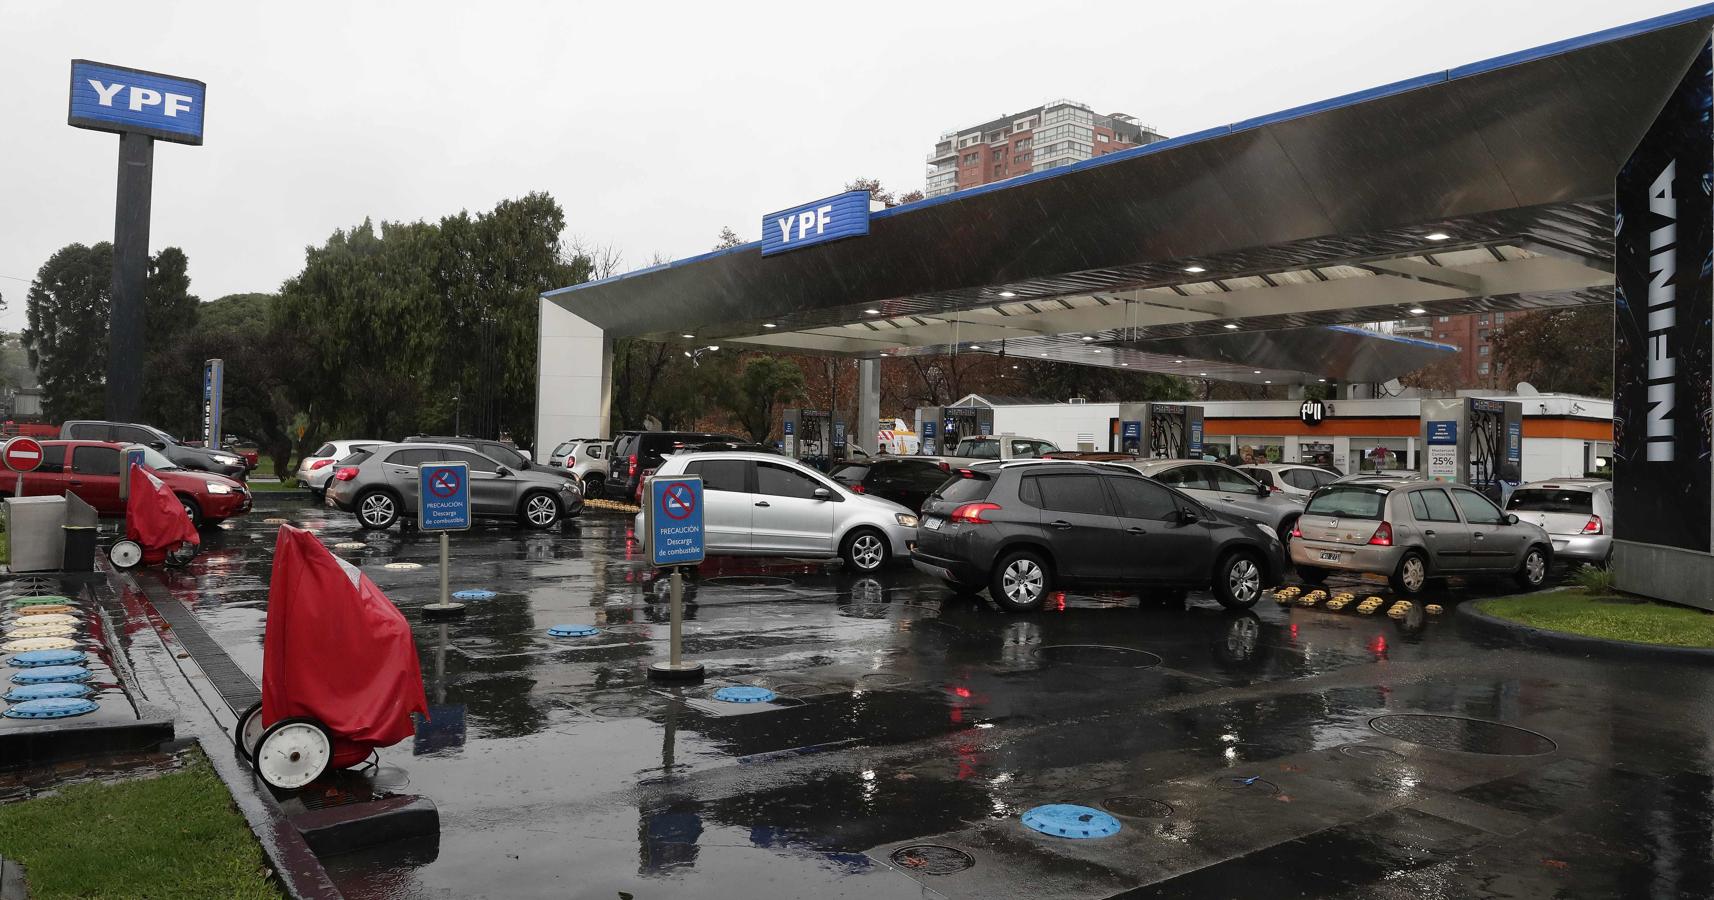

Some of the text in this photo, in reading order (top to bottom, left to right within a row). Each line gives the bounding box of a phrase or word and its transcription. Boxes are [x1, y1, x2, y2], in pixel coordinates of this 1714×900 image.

[87, 79, 193, 117] YPF
[778, 205, 832, 243] YPF
[1647, 158, 1677, 462] INFINIA
[1432, 457, 1454, 466] 25%
[426, 501, 464, 509] PRECAUCIÓN
[660, 525, 700, 535] PRECAUCIÓN
[667, 538, 693, 546] Descarga
[667, 547, 701, 556] combustible
